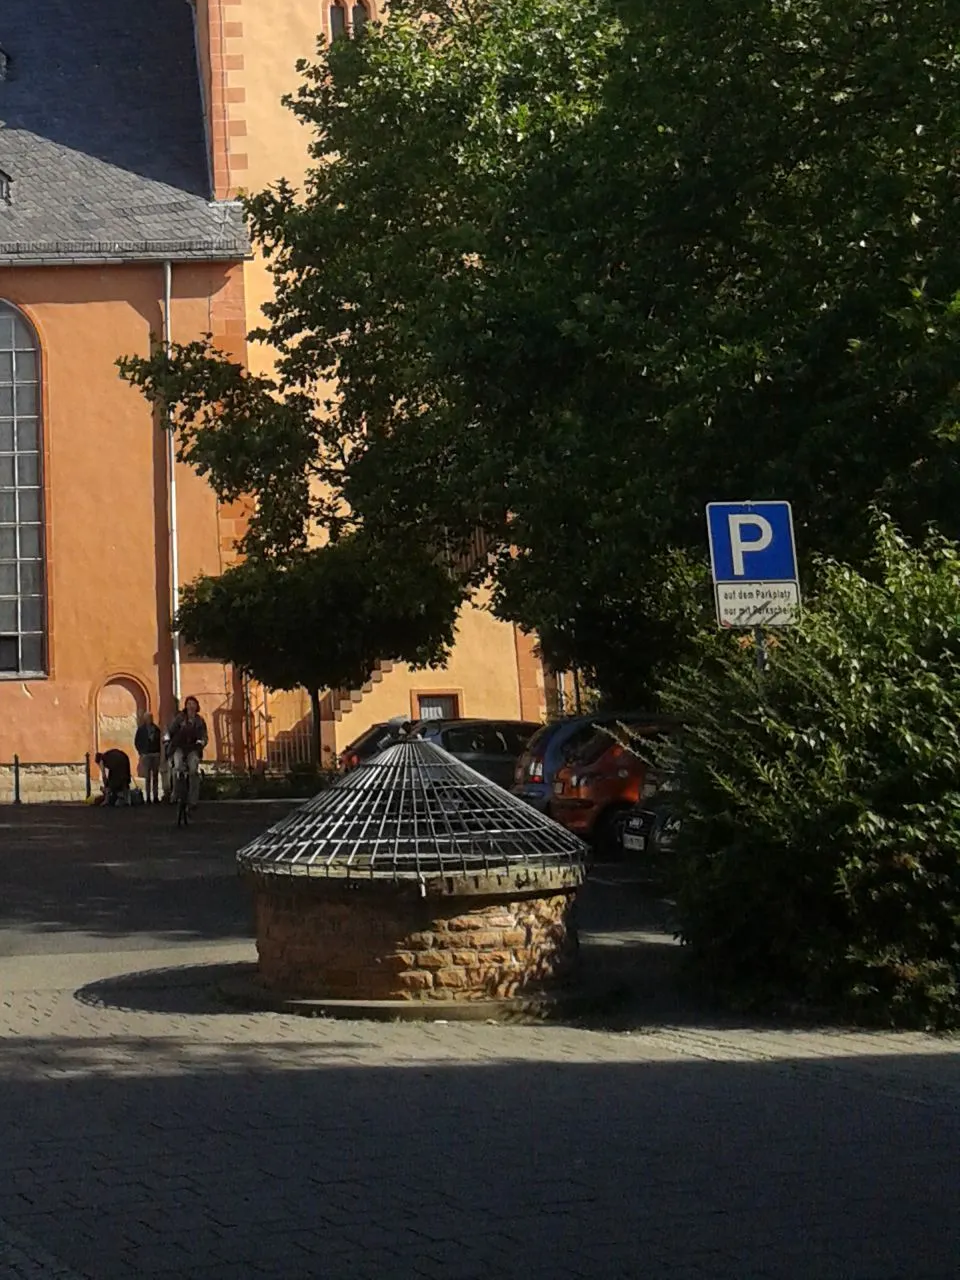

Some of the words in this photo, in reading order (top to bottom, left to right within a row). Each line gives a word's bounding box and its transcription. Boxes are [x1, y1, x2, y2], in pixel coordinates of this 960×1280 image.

[728, 513, 773, 576] P
[724, 589, 736, 600] auf
[738, 589, 754, 600] dem
[756, 588, 791, 602] Parkplatz
[724, 606, 736, 615] nur
